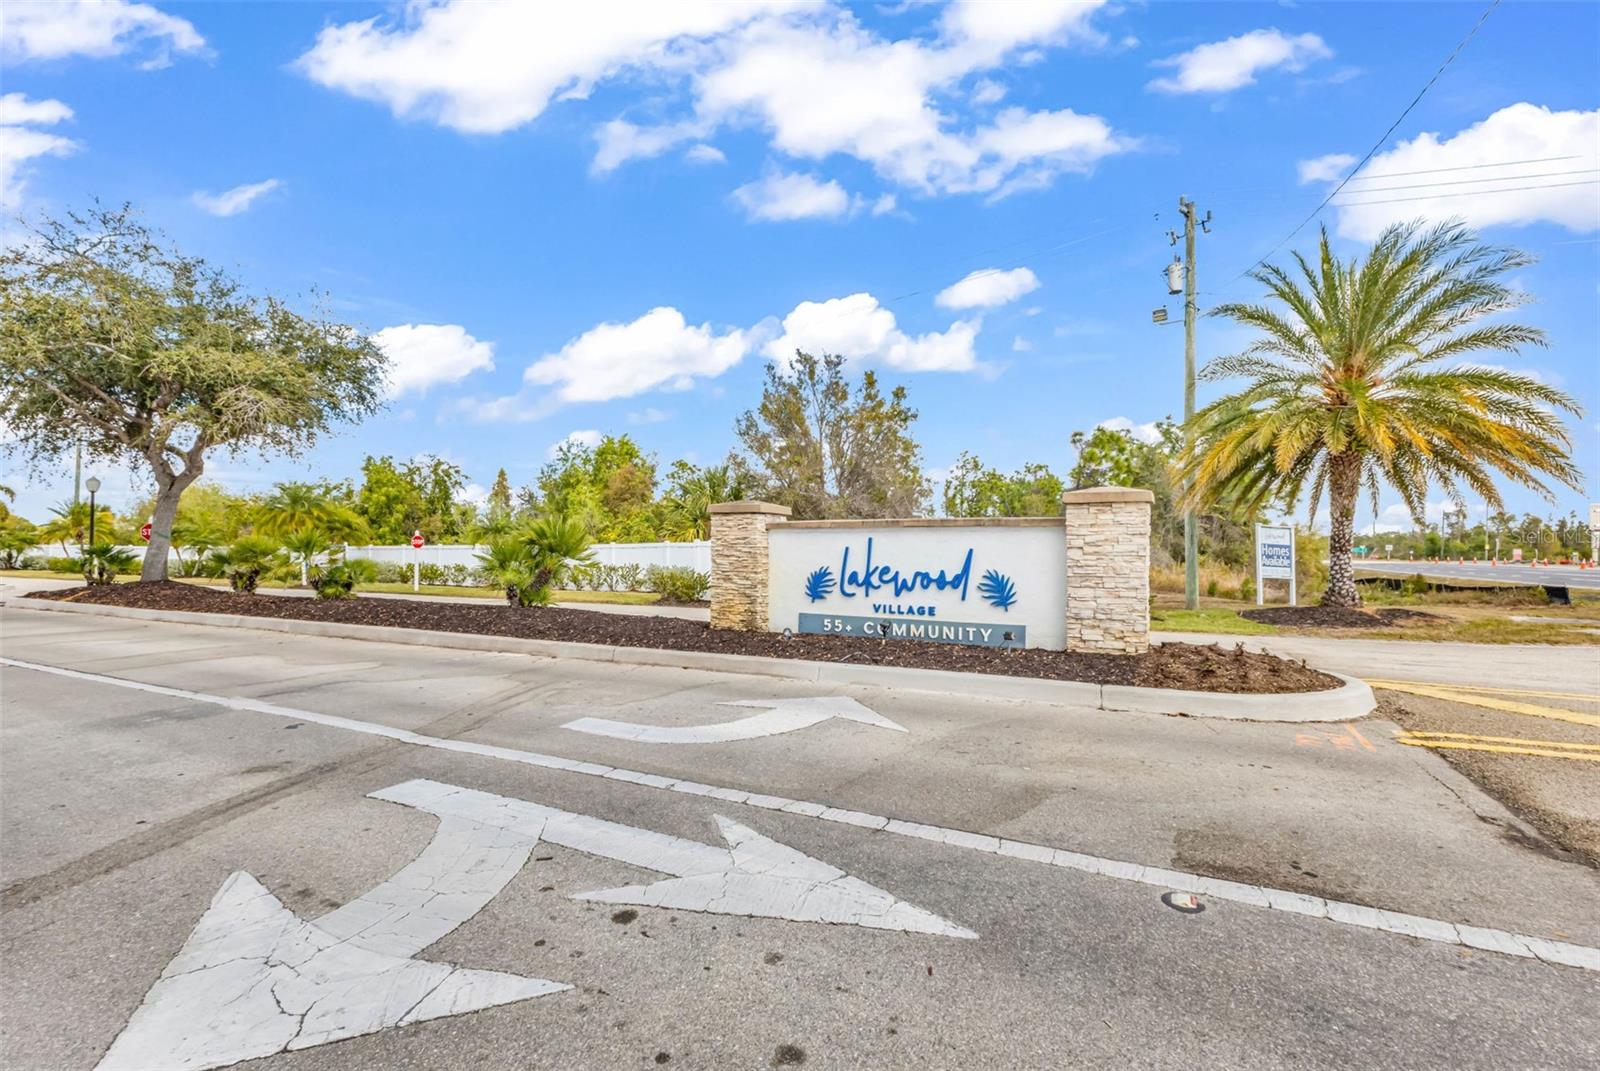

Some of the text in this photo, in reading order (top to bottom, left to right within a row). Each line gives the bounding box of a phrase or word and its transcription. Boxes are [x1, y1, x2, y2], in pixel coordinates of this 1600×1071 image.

[1262, 544, 1290, 556] Homes
[873, 603, 936, 616] VILLAGE
[823, 618, 853, 633] 55+
